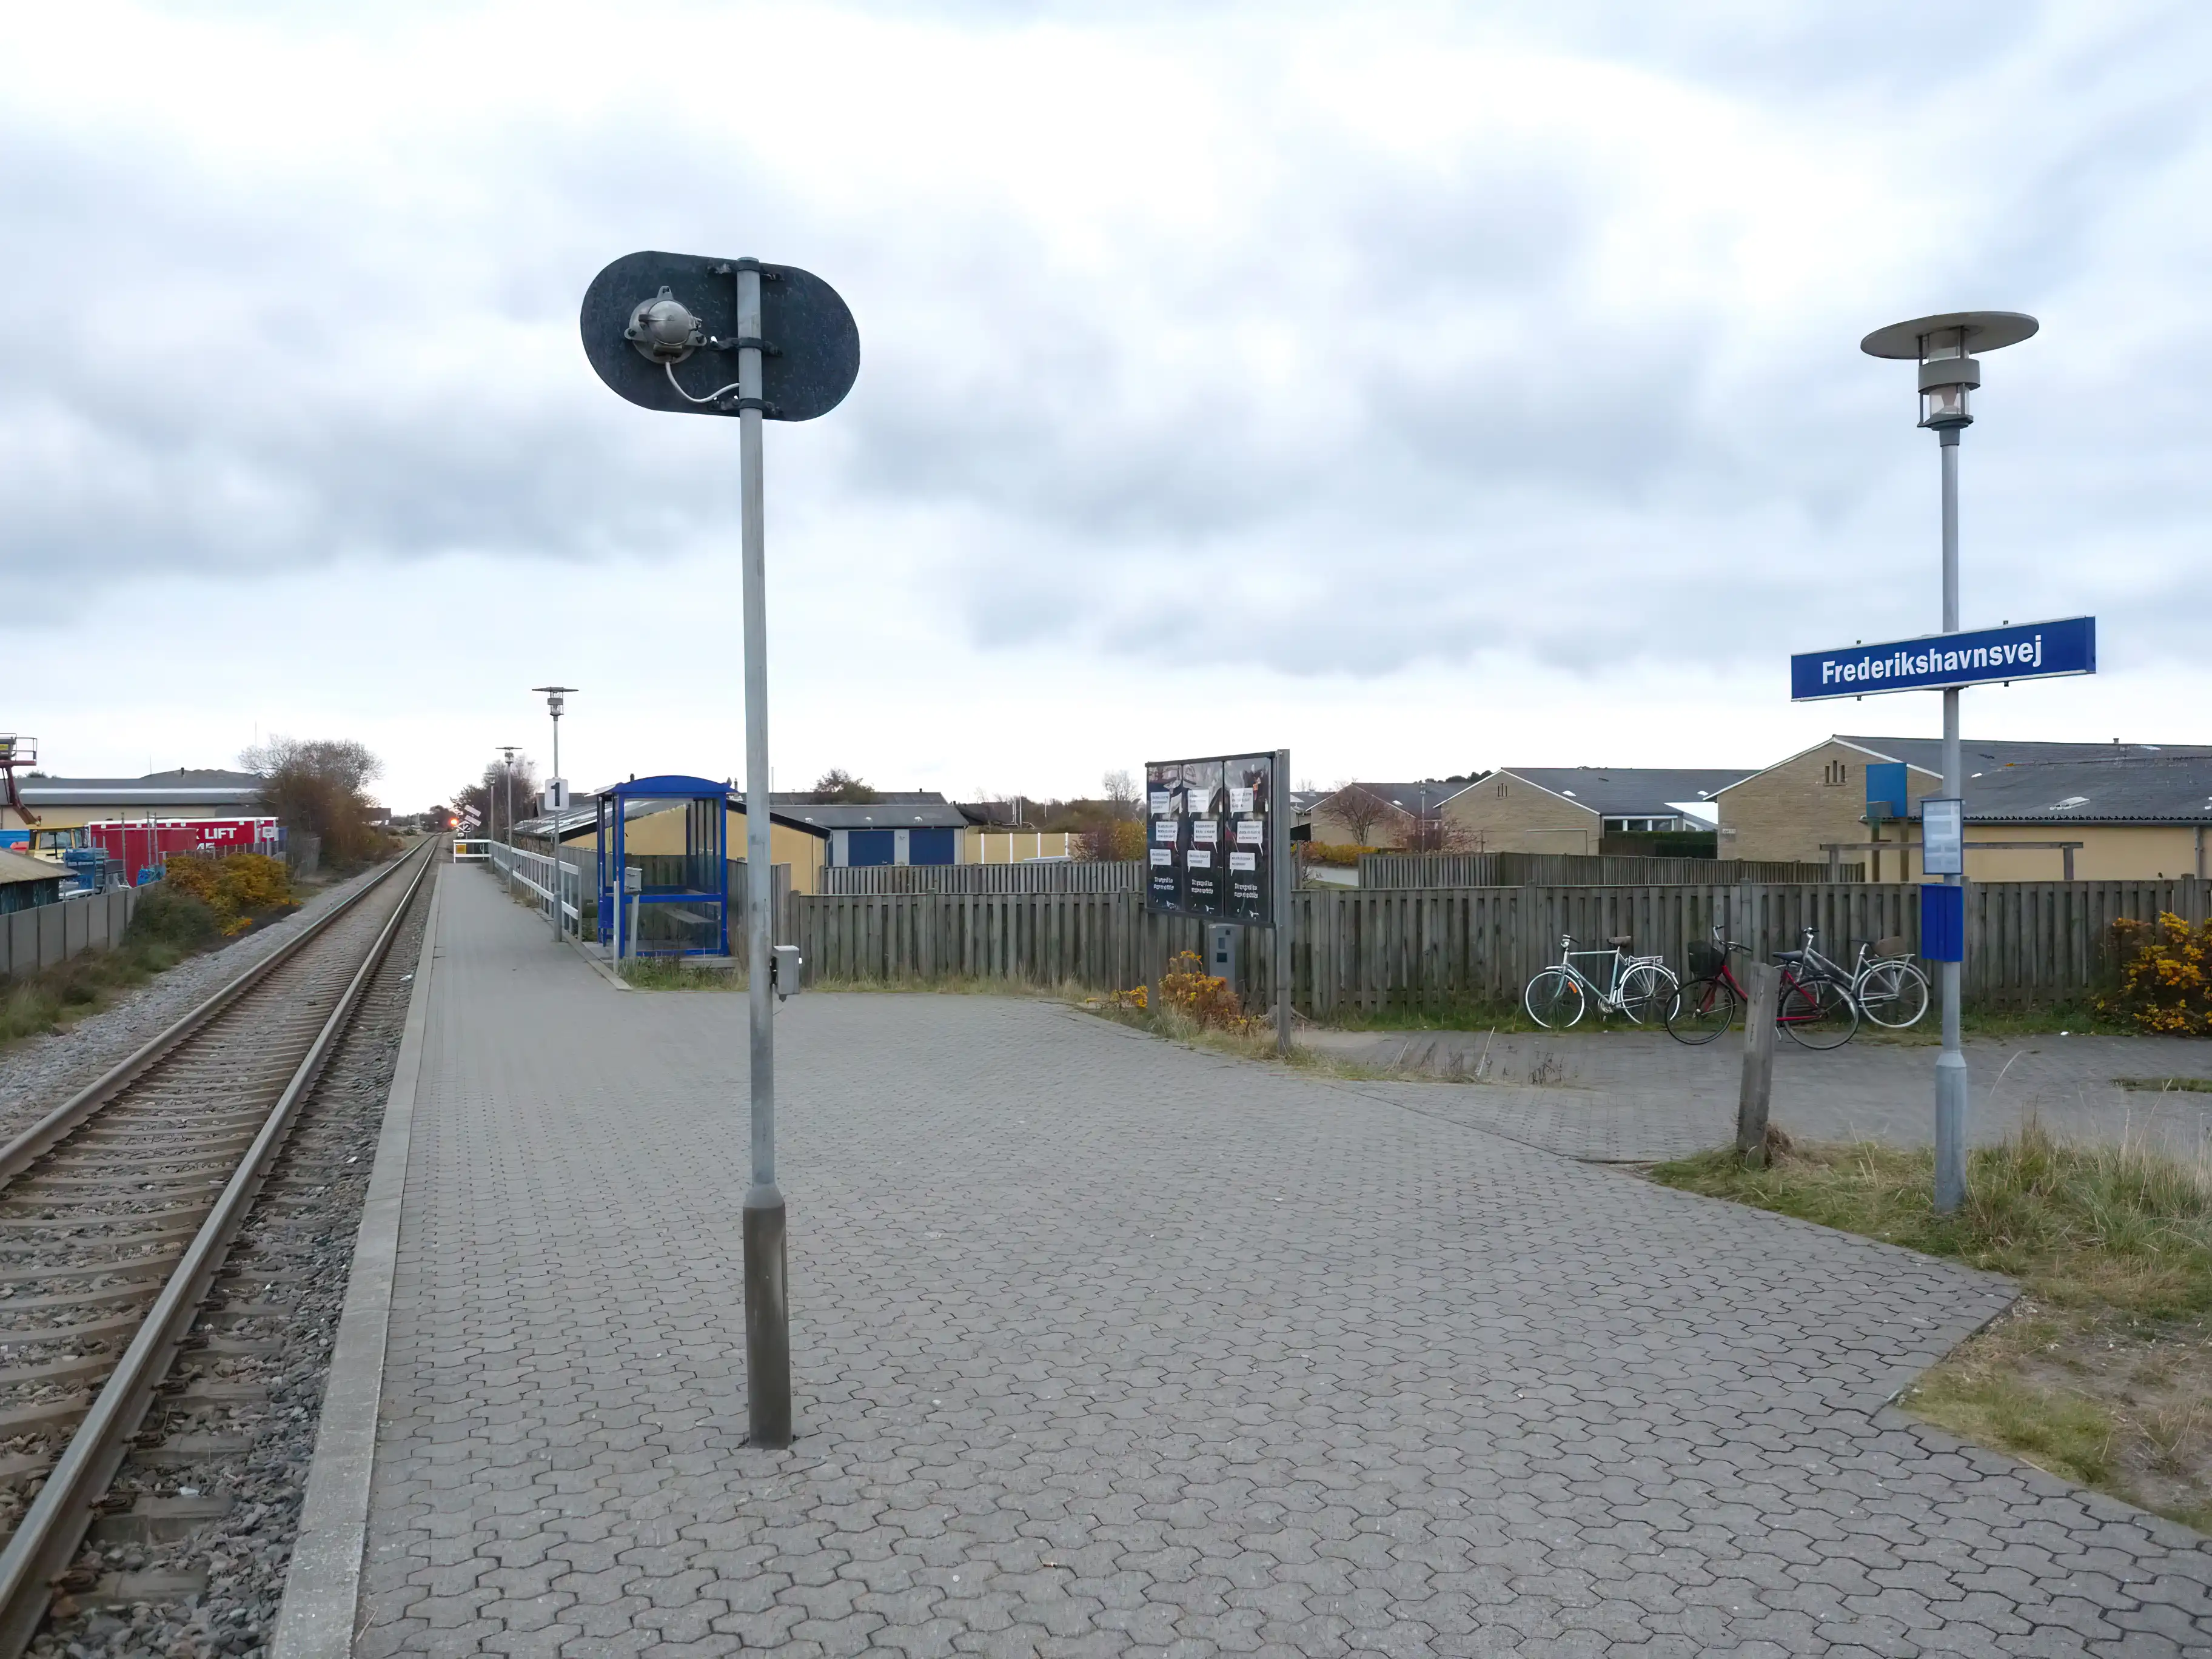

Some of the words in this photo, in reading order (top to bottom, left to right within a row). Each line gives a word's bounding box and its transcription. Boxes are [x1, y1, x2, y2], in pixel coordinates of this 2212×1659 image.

[1822, 634, 2042, 684] Frederikshavnsvej
[551, 782, 560, 806] 1
[204, 828, 237, 839] LIFT
